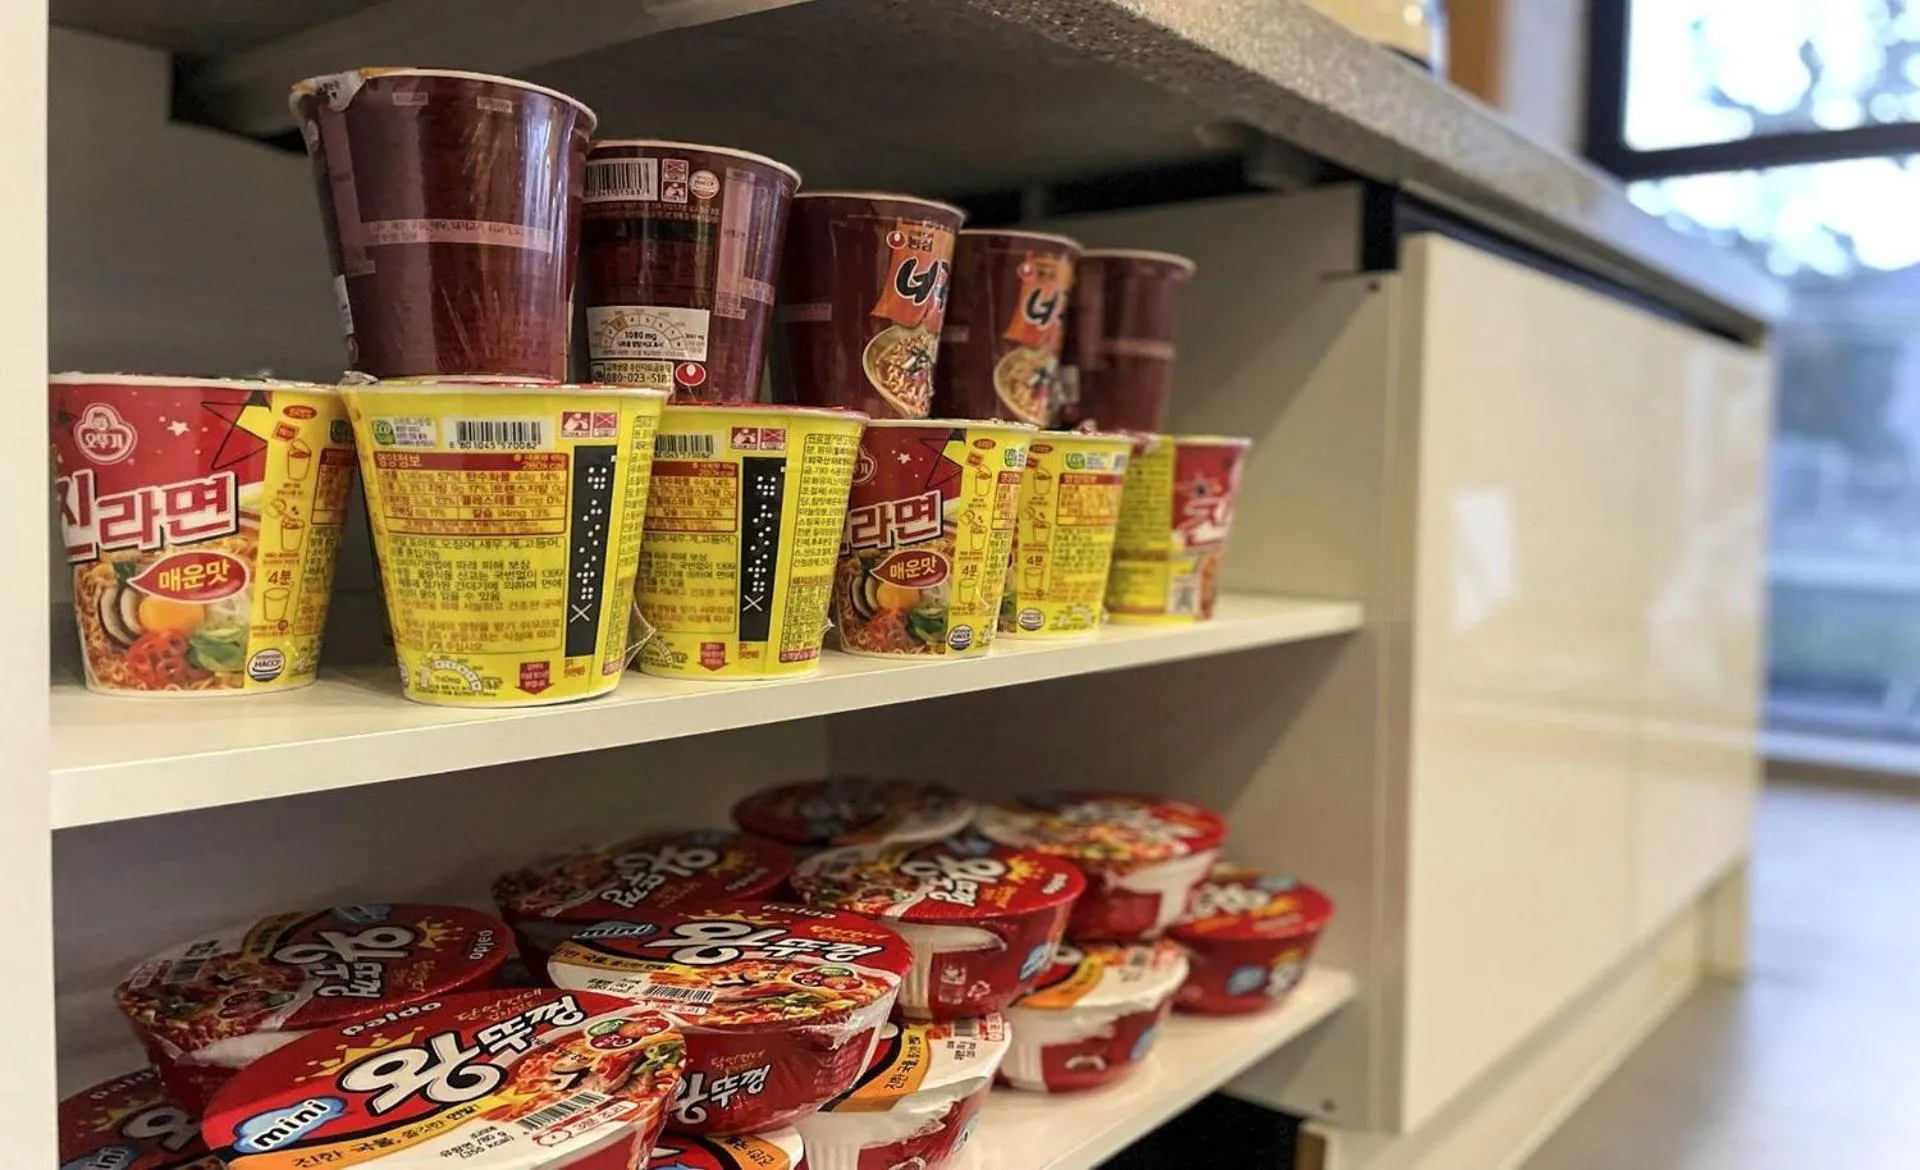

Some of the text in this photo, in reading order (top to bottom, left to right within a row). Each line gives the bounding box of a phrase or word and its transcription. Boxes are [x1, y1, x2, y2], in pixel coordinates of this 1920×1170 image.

[625, 330, 657, 341] 1080 mg
[840, 489, 943, 551] 라면
[158, 560, 231, 592] 매운맛
[267, 569, 292, 586] 4분
[889, 555, 938, 581] 매운맛
[643, 920, 884, 965] 왕뚜껑
[341, 1001, 444, 1037] paldo
[339, 995, 586, 1116] 왕뚜껑
[674, 1063, 771, 1125] 왕뚜껑
[251, 1098, 330, 1151] mini
[292, 1149, 343, 1168] 진한
